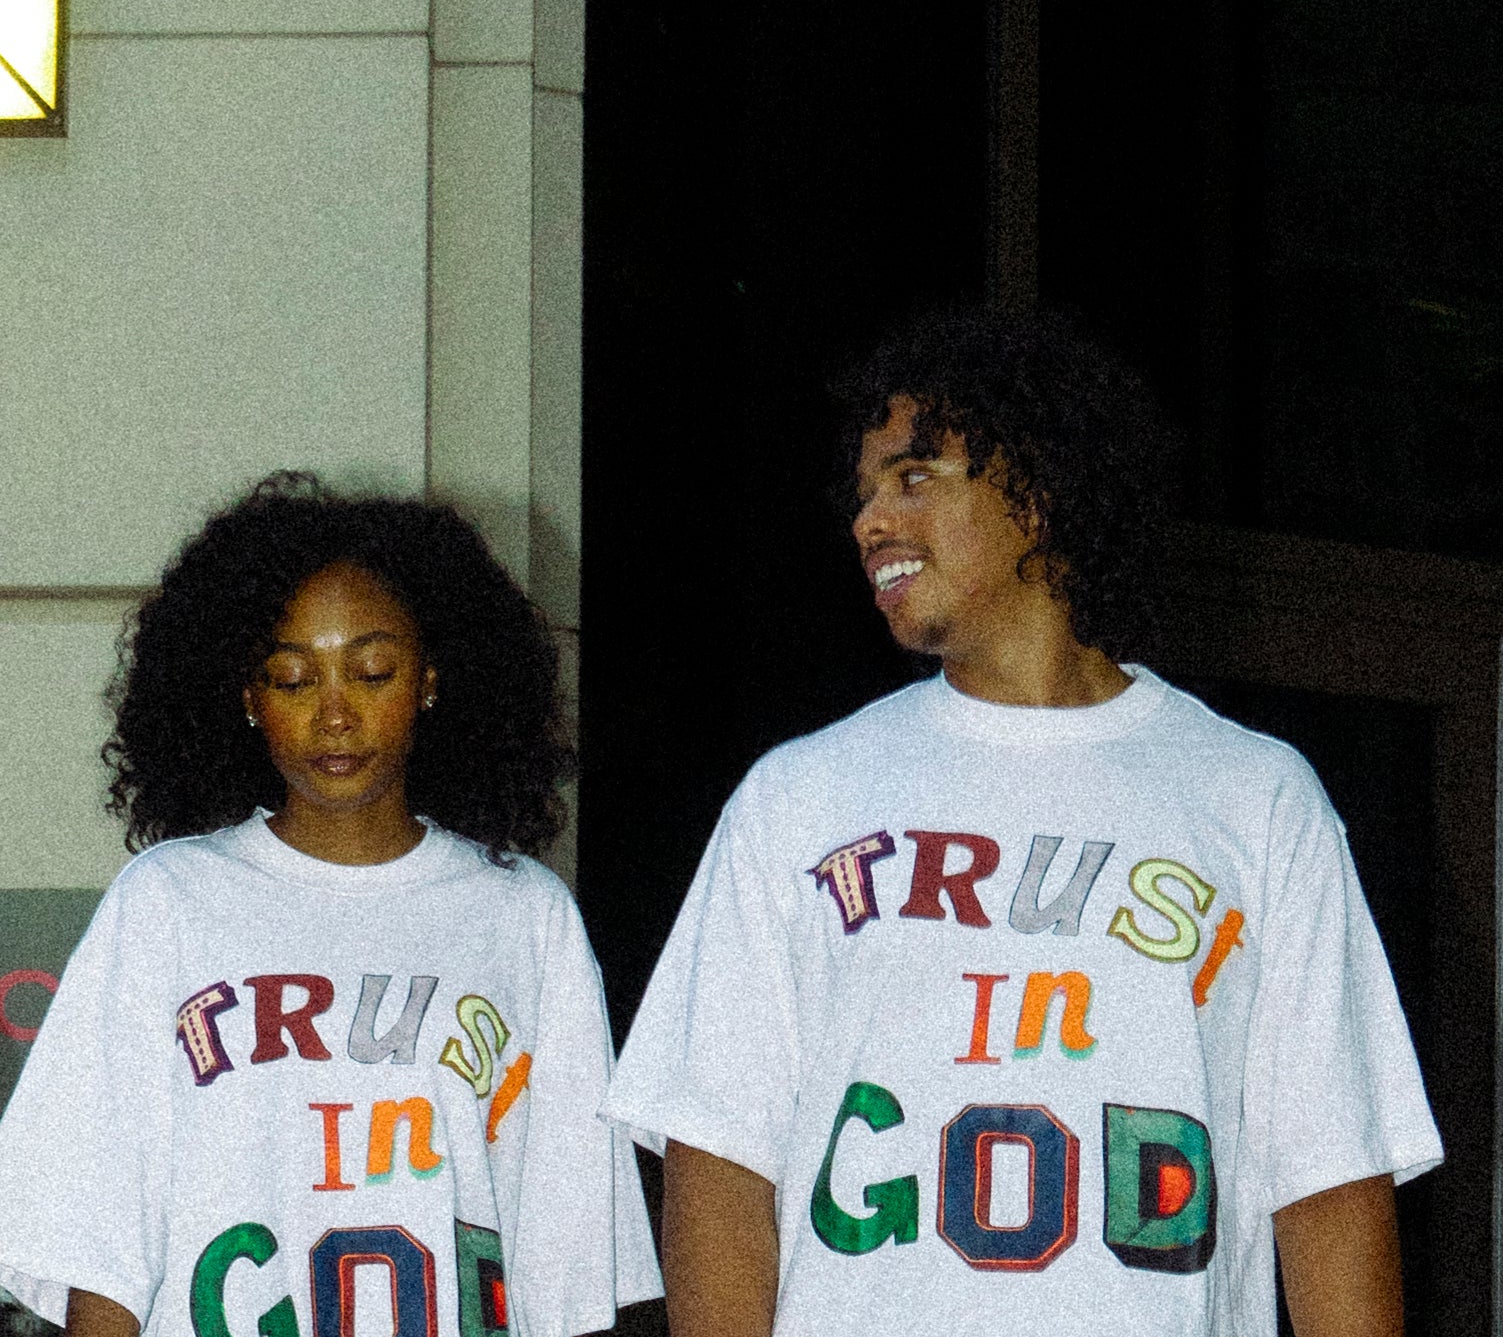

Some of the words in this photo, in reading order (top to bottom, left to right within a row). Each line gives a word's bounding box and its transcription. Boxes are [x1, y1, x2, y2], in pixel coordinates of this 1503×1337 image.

[954, 971, 1098, 1064] In
[308, 1097, 445, 1191] In
[811, 1081, 1218, 1275] GOD
